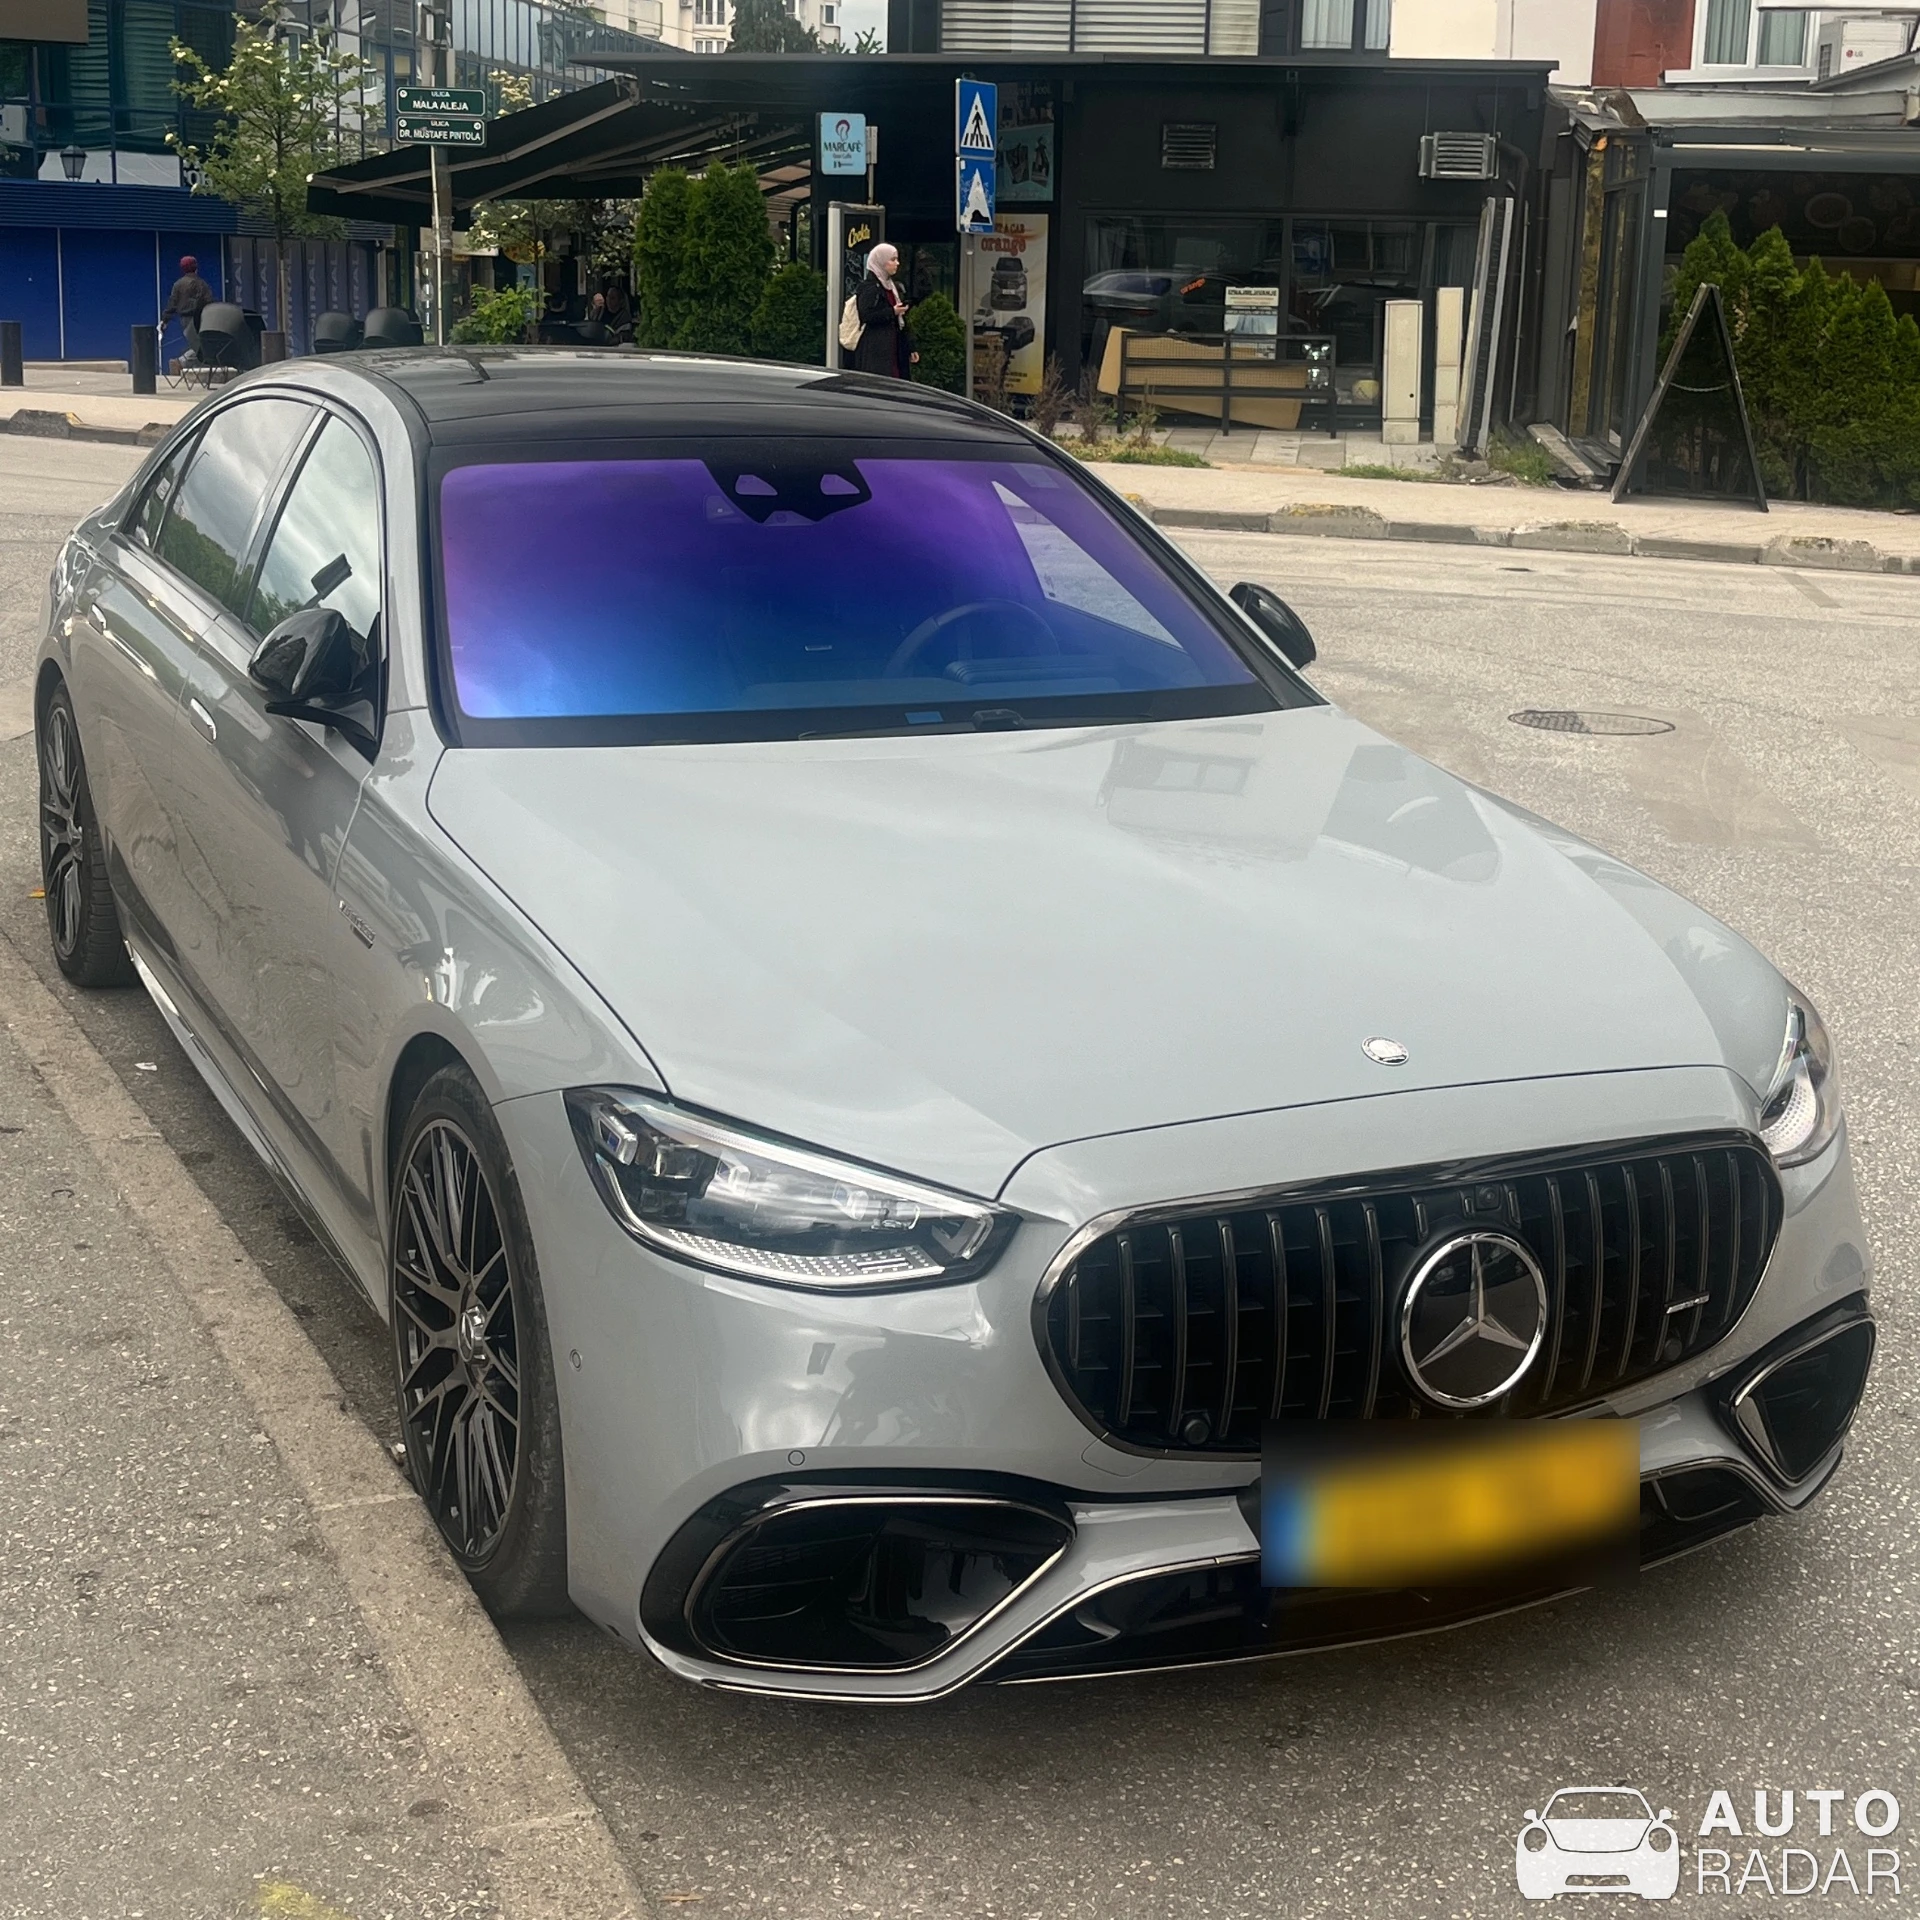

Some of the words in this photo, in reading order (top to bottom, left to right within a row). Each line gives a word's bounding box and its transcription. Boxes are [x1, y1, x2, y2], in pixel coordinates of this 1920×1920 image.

[412, 100, 439, 110] MALA
[439, 101, 469, 111] ALEJA
[399, 129, 412, 138] DR.
[413, 129, 448, 140] MUSTAFE
[449, 130, 481, 141] PINTOLA
